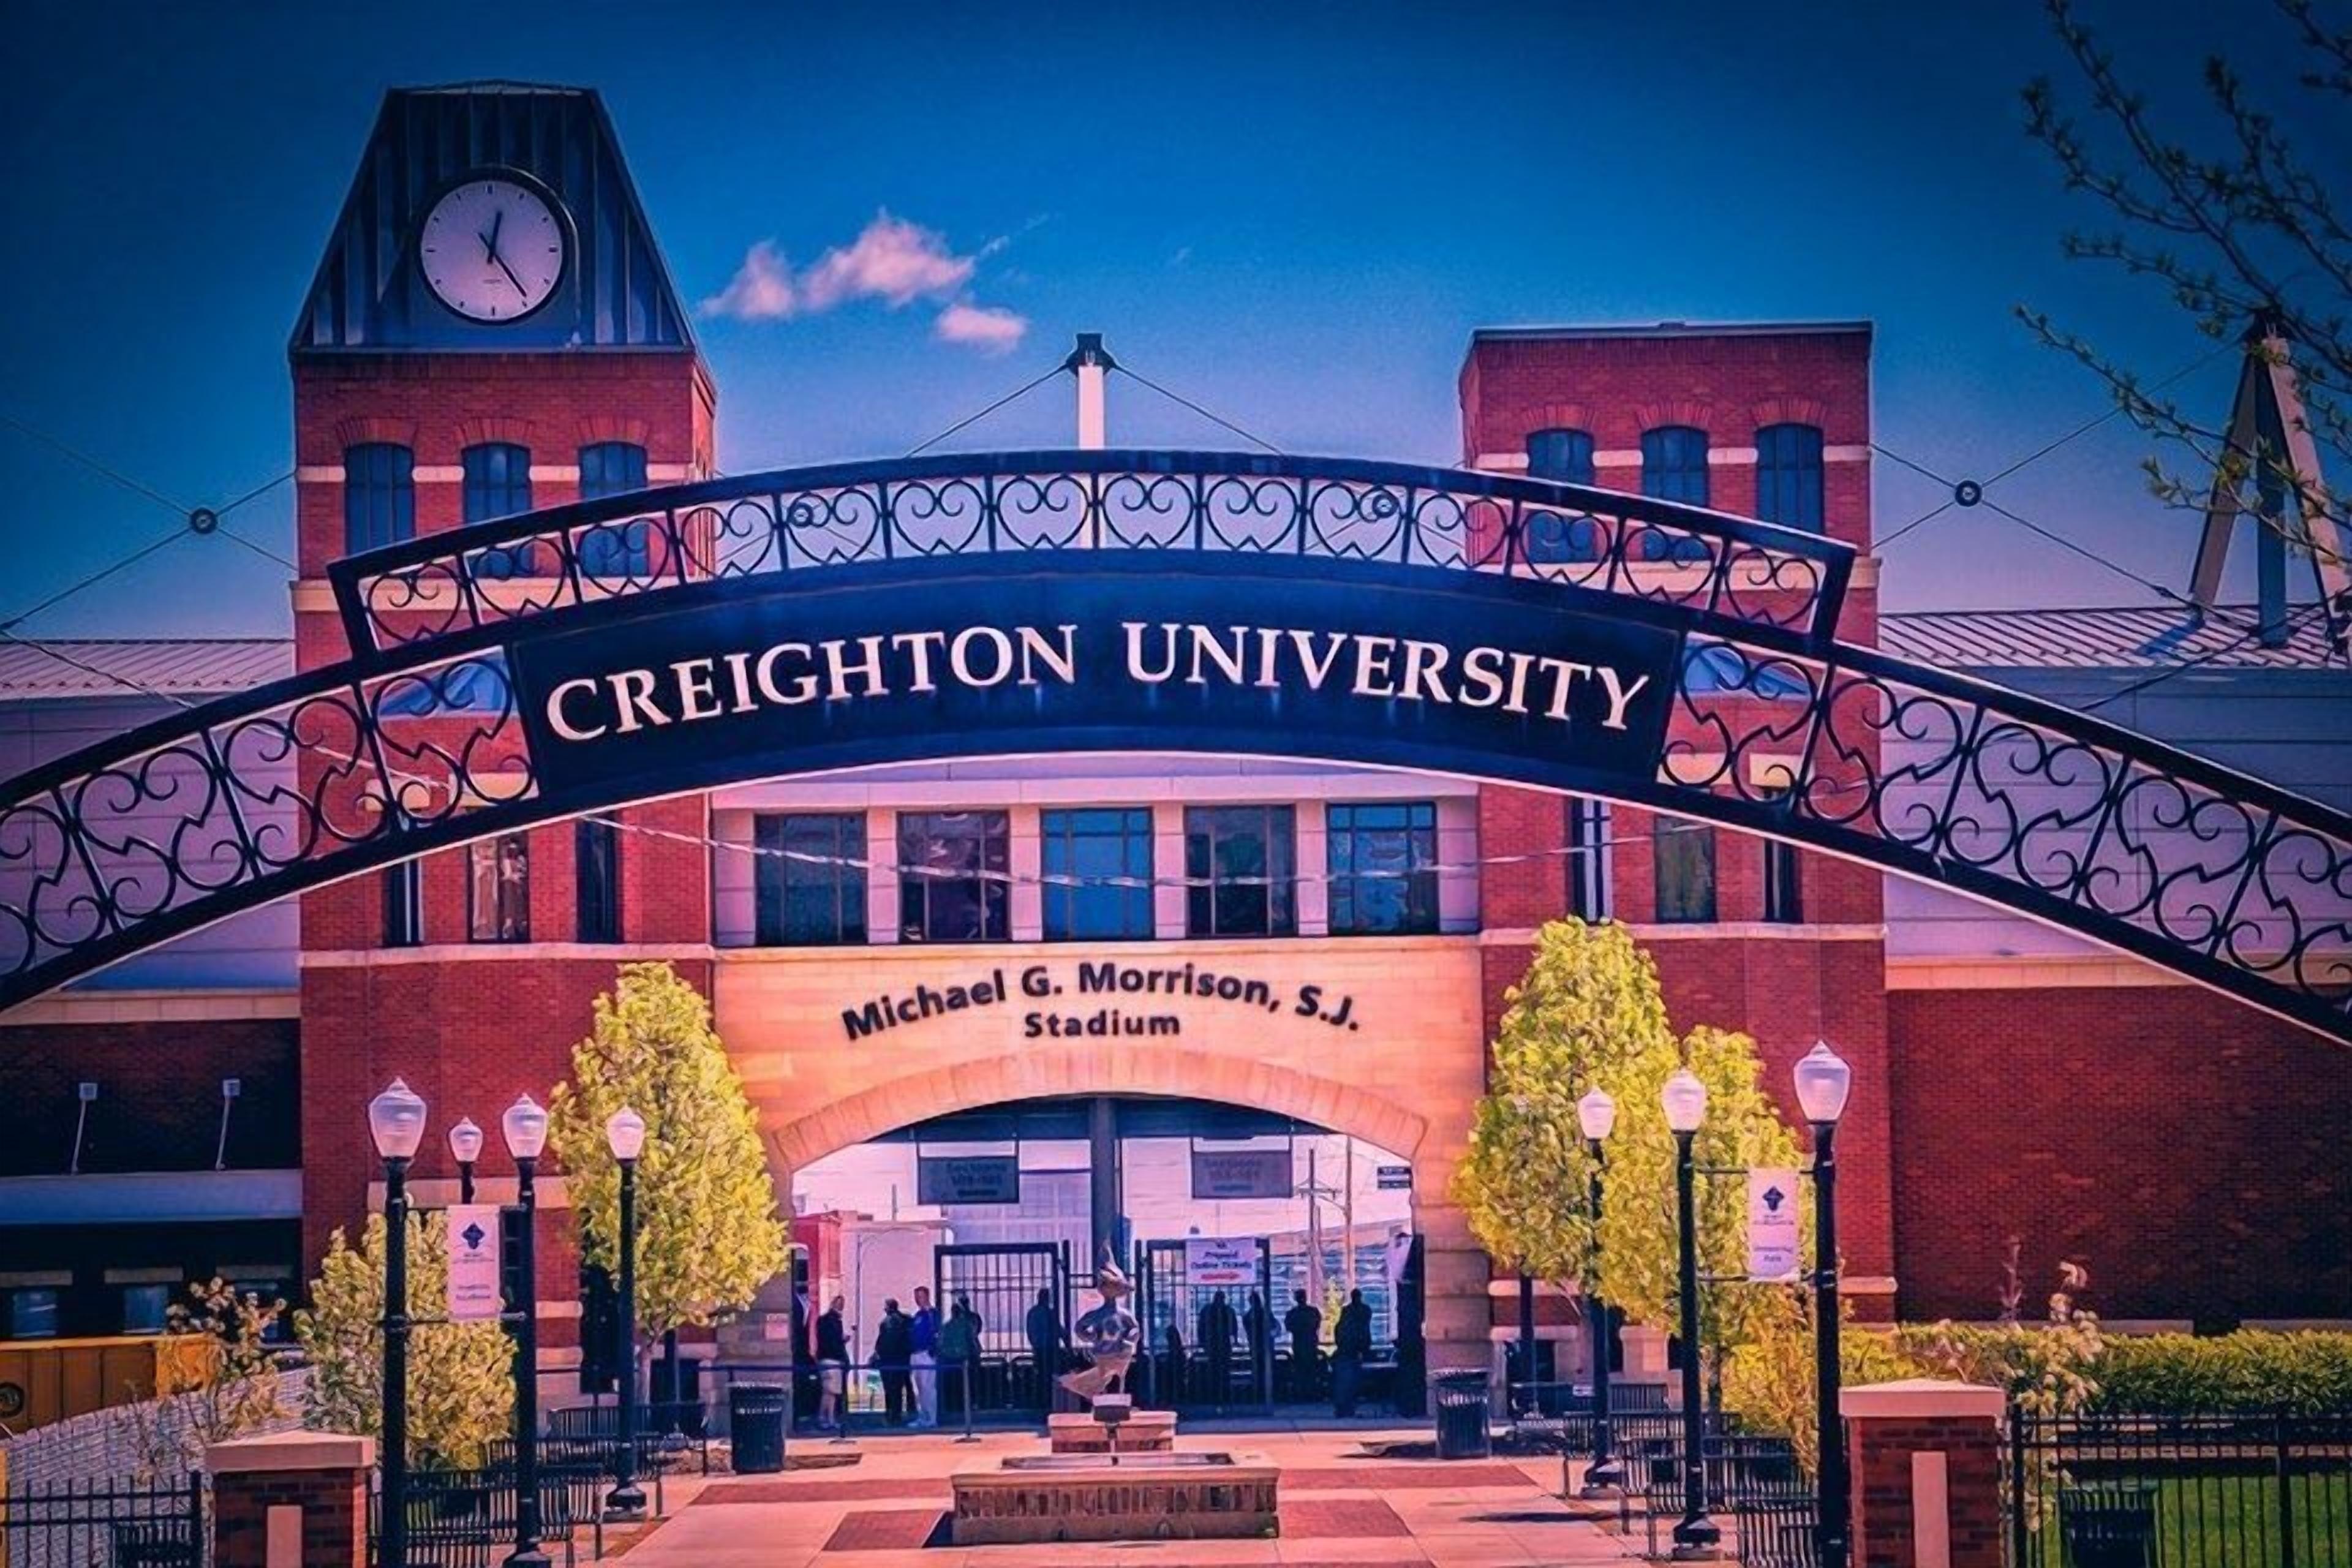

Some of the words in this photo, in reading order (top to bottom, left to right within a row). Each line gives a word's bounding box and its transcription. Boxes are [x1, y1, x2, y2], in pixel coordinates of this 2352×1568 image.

[546, 624, 1078, 741] CREIGHTON
[1121, 621, 1649, 731] UNIVERSITY
[842, 968, 1006, 1041] Michael
[1021, 965, 1063, 998] G.
[1078, 962, 1281, 1014] Morrison,
[1294, 984, 1359, 1031] S.J.
[1024, 1008, 1180, 1038] Stadium
